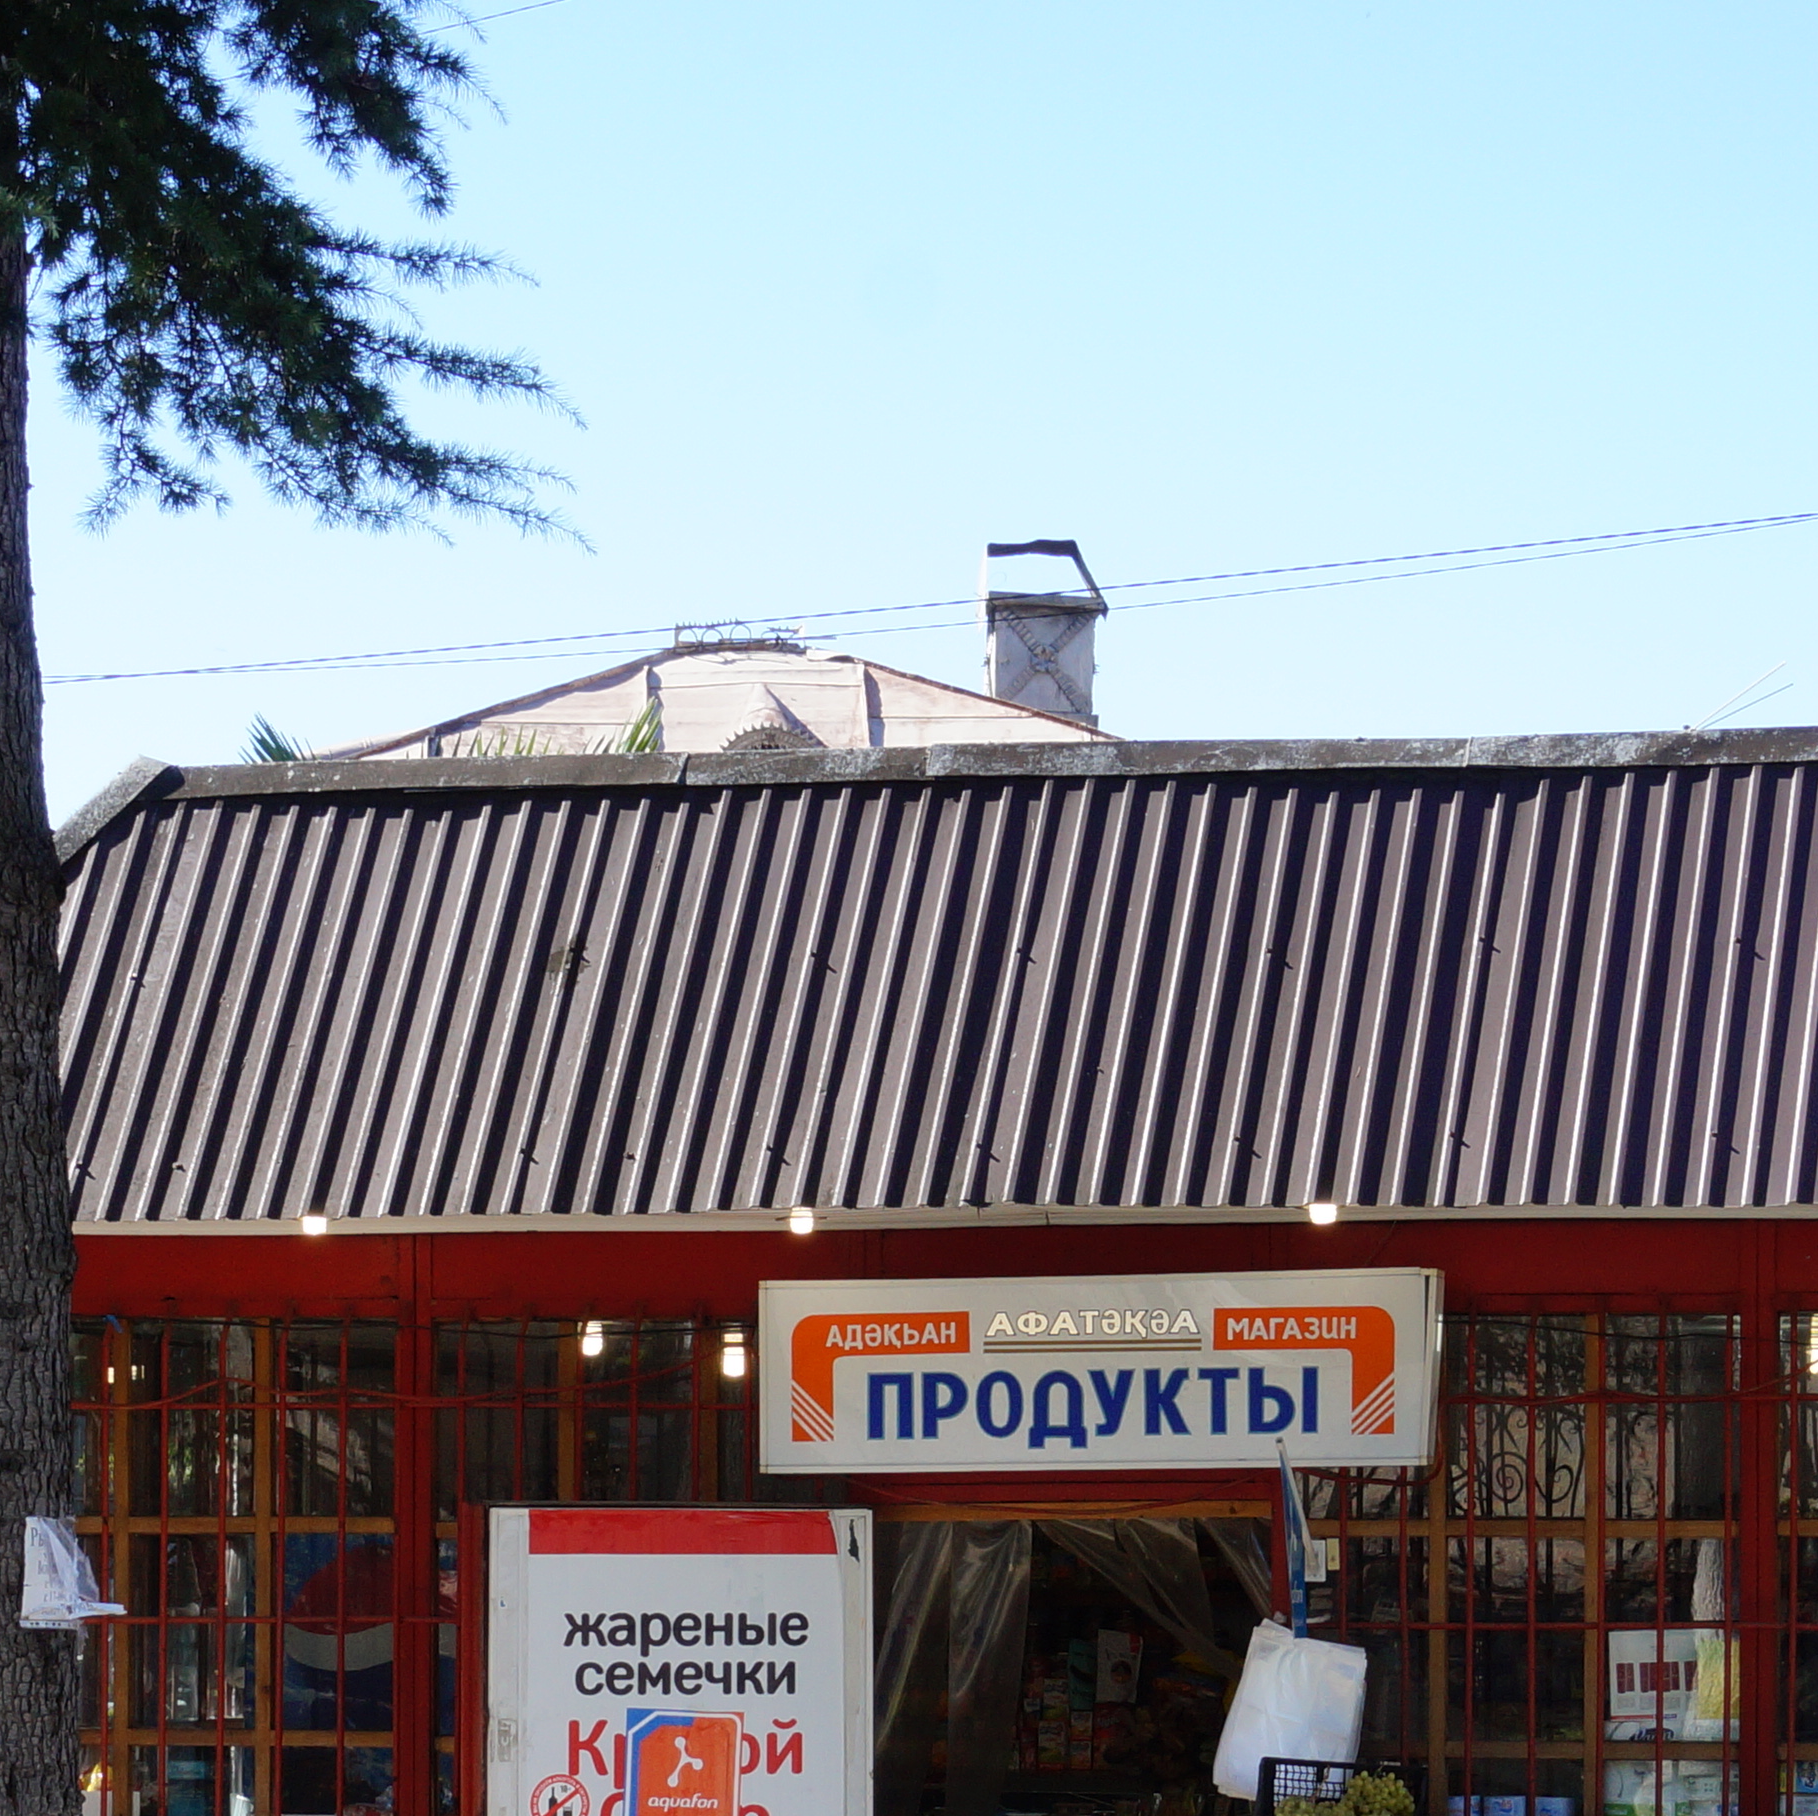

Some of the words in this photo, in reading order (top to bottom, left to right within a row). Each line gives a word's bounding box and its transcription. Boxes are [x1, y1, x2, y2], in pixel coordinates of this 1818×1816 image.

[984, 1308, 1201, 1339] АФАТӘҚӘА
[1226, 1316, 1357, 1341] МАГАЗИН
[865, 1365, 1319, 1449] ПРОДУКТЫ
[563, 1612, 809, 1657] жареные
[574, 1660, 797, 1695] семечки
[647, 1793, 719, 1812] aquafon
